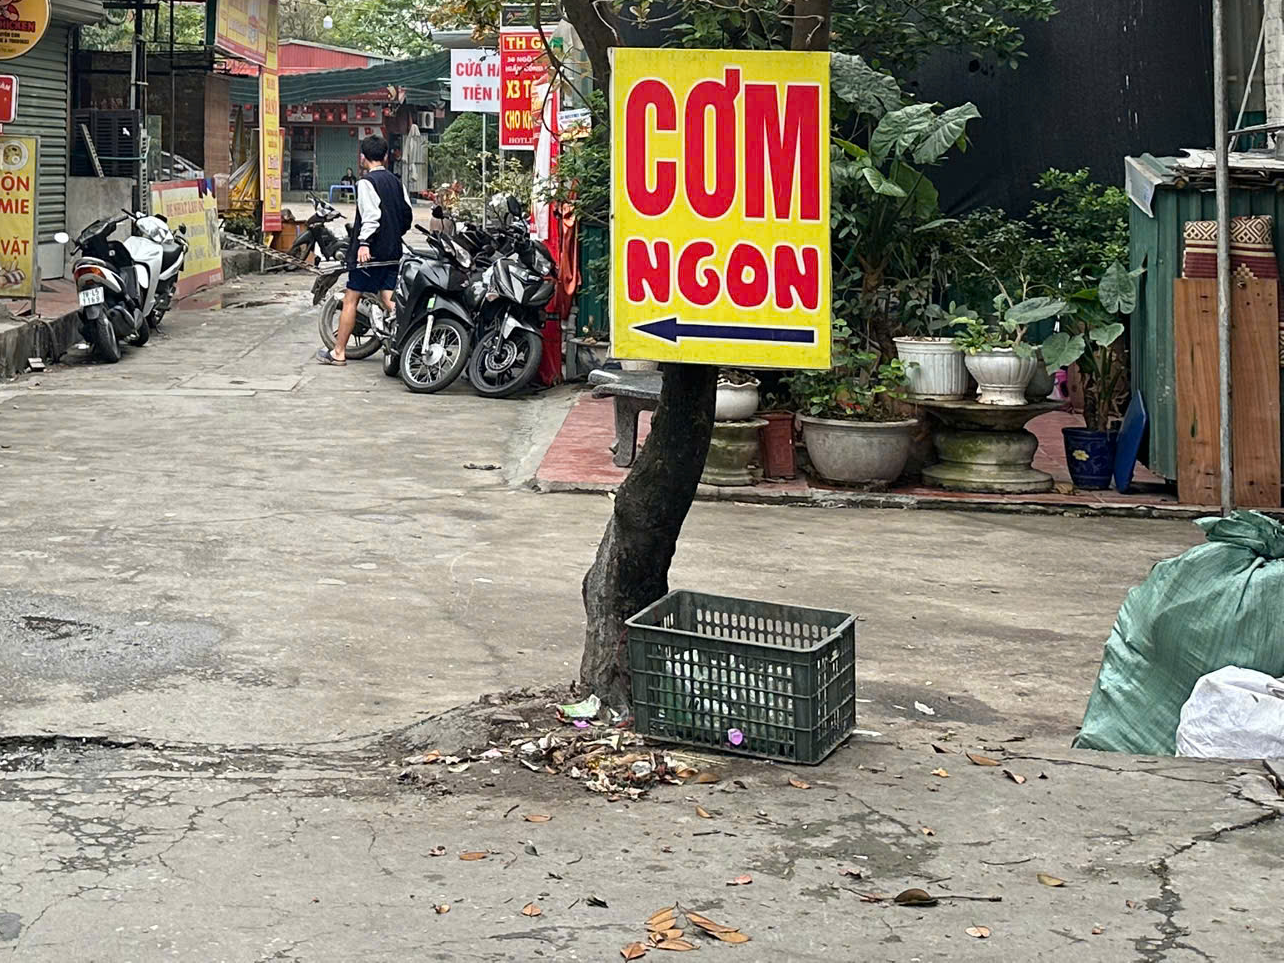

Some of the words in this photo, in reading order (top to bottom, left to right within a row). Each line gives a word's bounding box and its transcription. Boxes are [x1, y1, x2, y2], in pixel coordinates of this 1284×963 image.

[506, 36, 526, 49] TH
[456, 58, 483, 77] CỬA
[462, 84, 492, 104] TIỆN
[506, 79, 521, 99] X3
[505, 110, 521, 130] CHO
[625, 68, 820, 221] CƠM
[0, 236, 29, 260] VẶT
[626, 238, 820, 310] NGON
